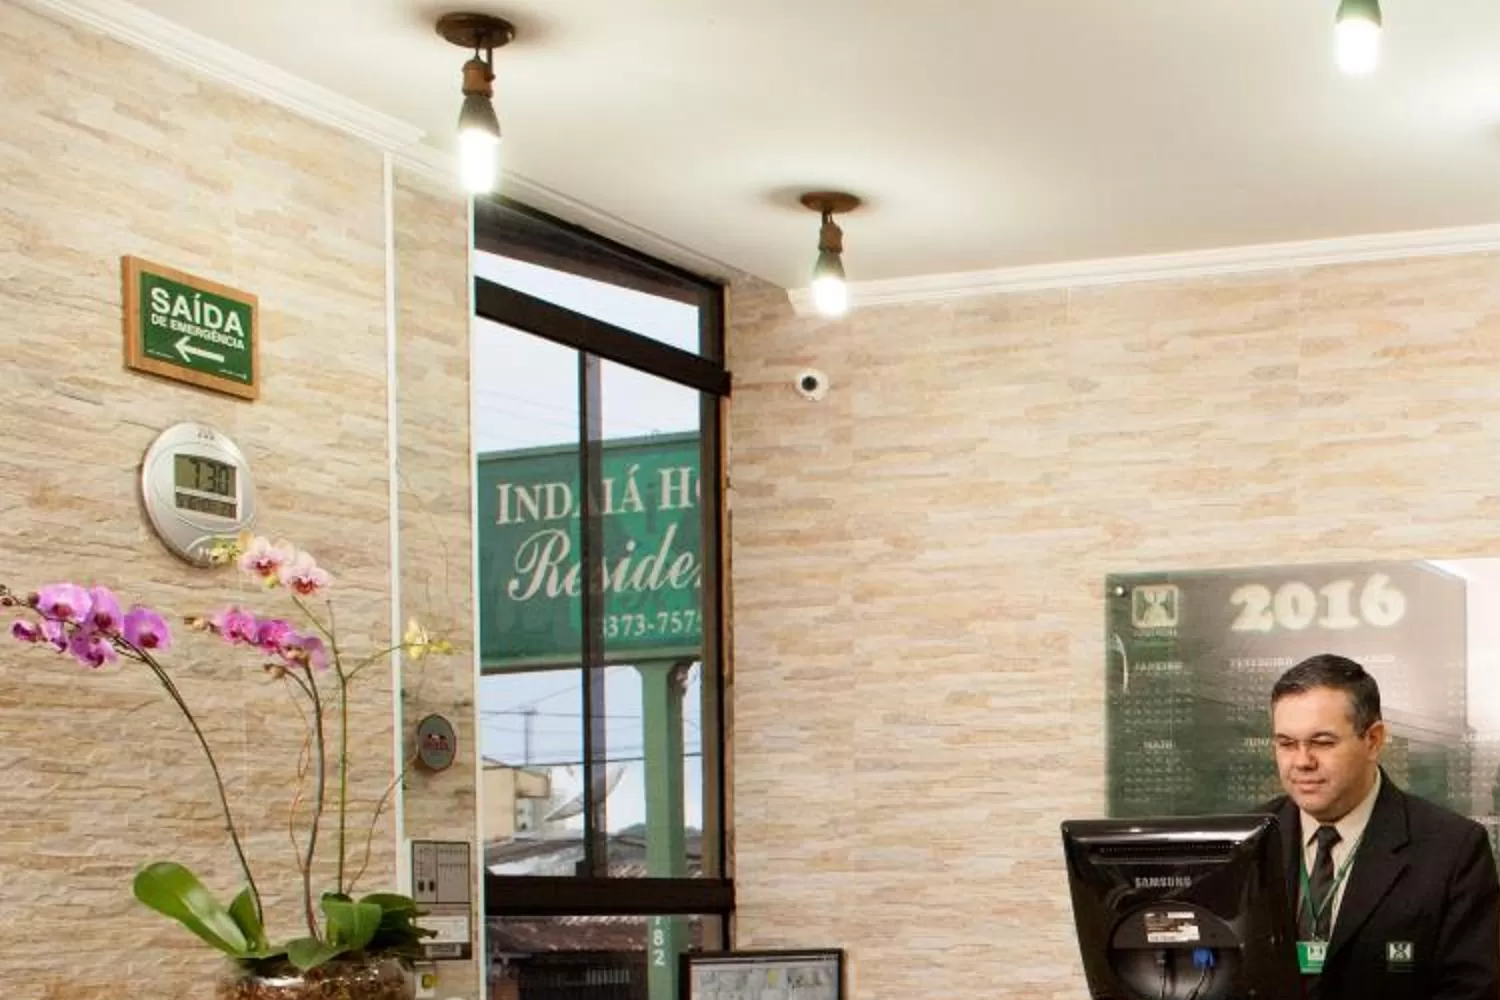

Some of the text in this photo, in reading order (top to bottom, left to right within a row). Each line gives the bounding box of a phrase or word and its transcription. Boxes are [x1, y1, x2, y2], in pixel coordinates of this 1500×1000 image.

[151, 287, 244, 337] SAÍDA
[151, 313, 245, 349] DE EMERGÊNCIA
[496, 463, 701, 525] INDIÁ H
[603, 609, 702, 638] 373-757
[1229, 573, 1406, 633] 2016
[1135, 876, 1192, 888] SAMSUNG
